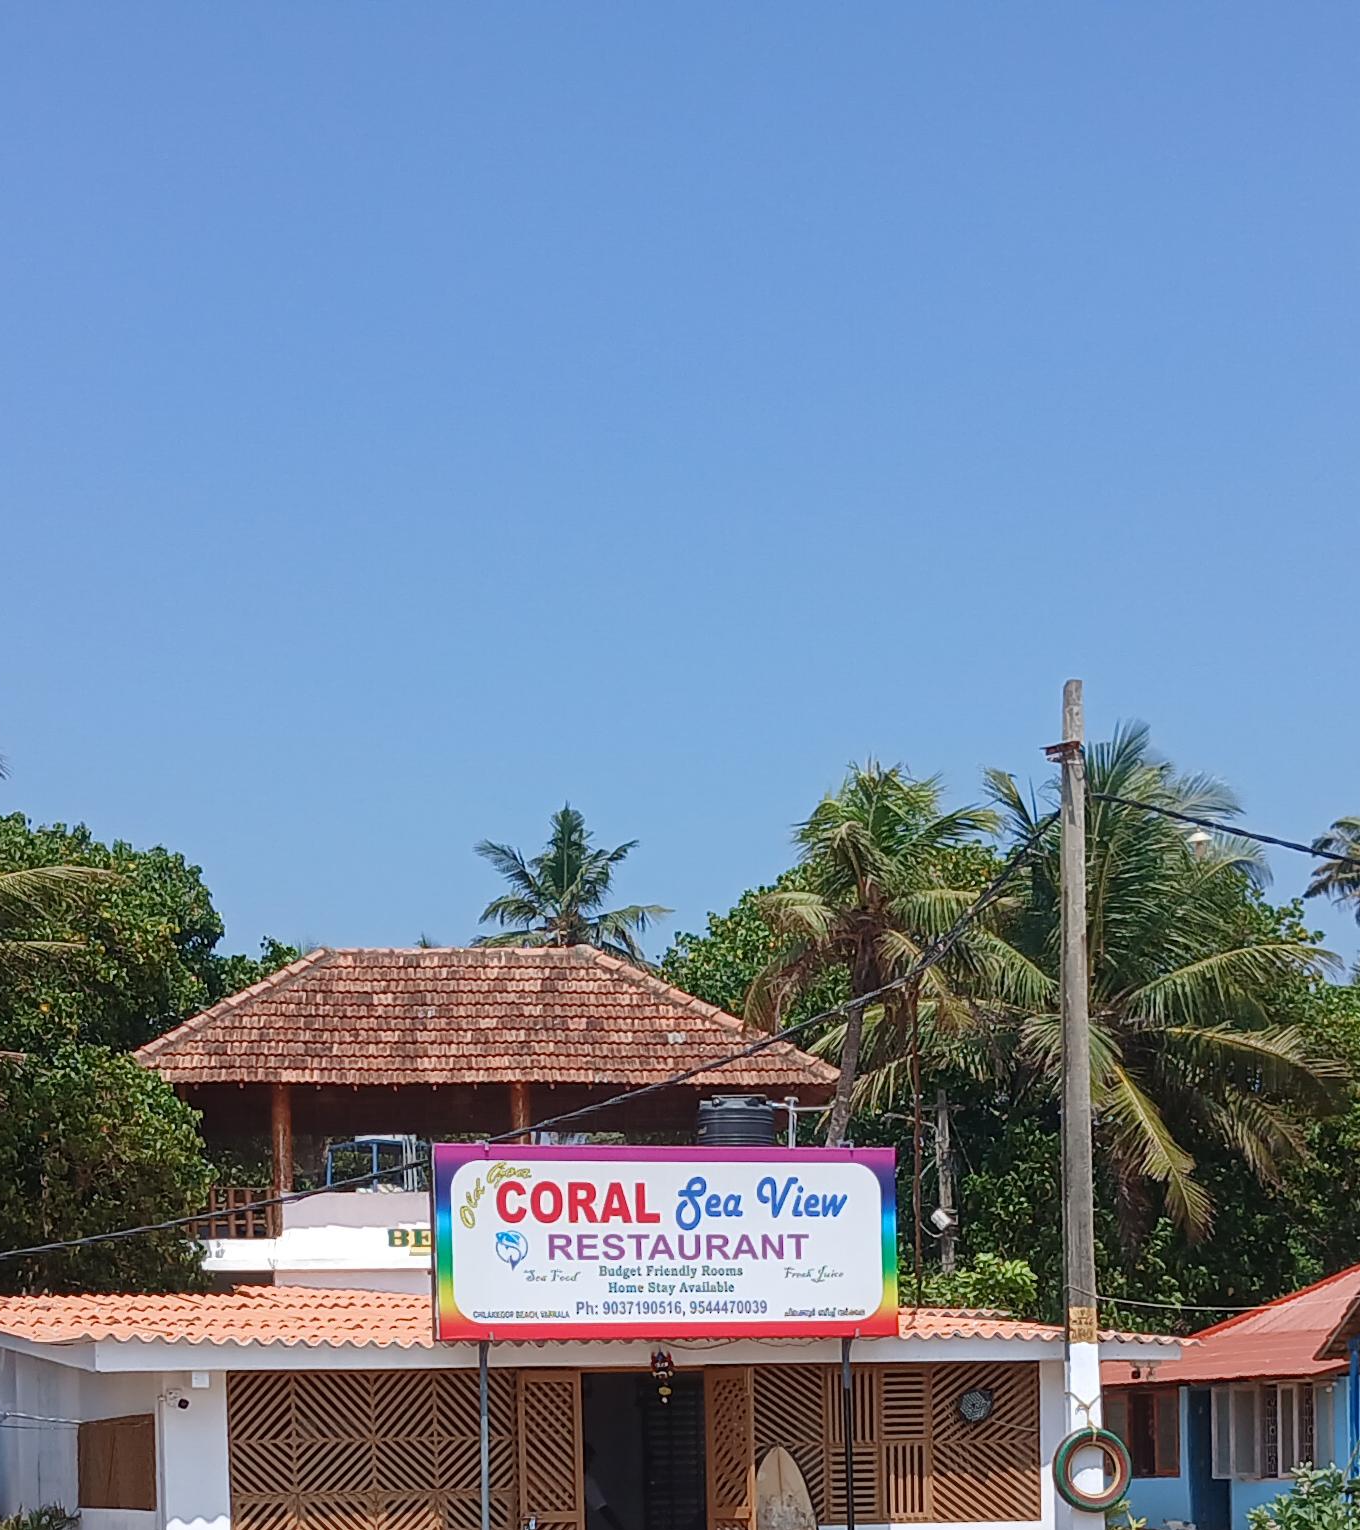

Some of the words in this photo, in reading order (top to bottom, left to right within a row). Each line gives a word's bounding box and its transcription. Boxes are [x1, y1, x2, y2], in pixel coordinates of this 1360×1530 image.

[496, 1181, 661, 1224] CORAL
[675, 1176, 743, 1231] Sea
[756, 1176, 848, 1218] View
[548, 1233, 810, 1261] RESTAURANT
[524, 1269, 547, 1282] Sea
[550, 1268, 581, 1283] Food
[598, 1265, 642, 1279] Budget
[646, 1265, 697, 1279] Friendly
[701, 1266, 744, 1277] Rooms
[811, 1265, 844, 1283] Juice
[608, 1282, 644, 1293] Home
[648, 1282, 675, 1296] Stay
[679, 1281, 735, 1293] Available
[576, 1301, 599, 1315] Ph:
[602, 1300, 686, 1317] 9037190516,
[689, 1300, 768, 1315] 9544470039
